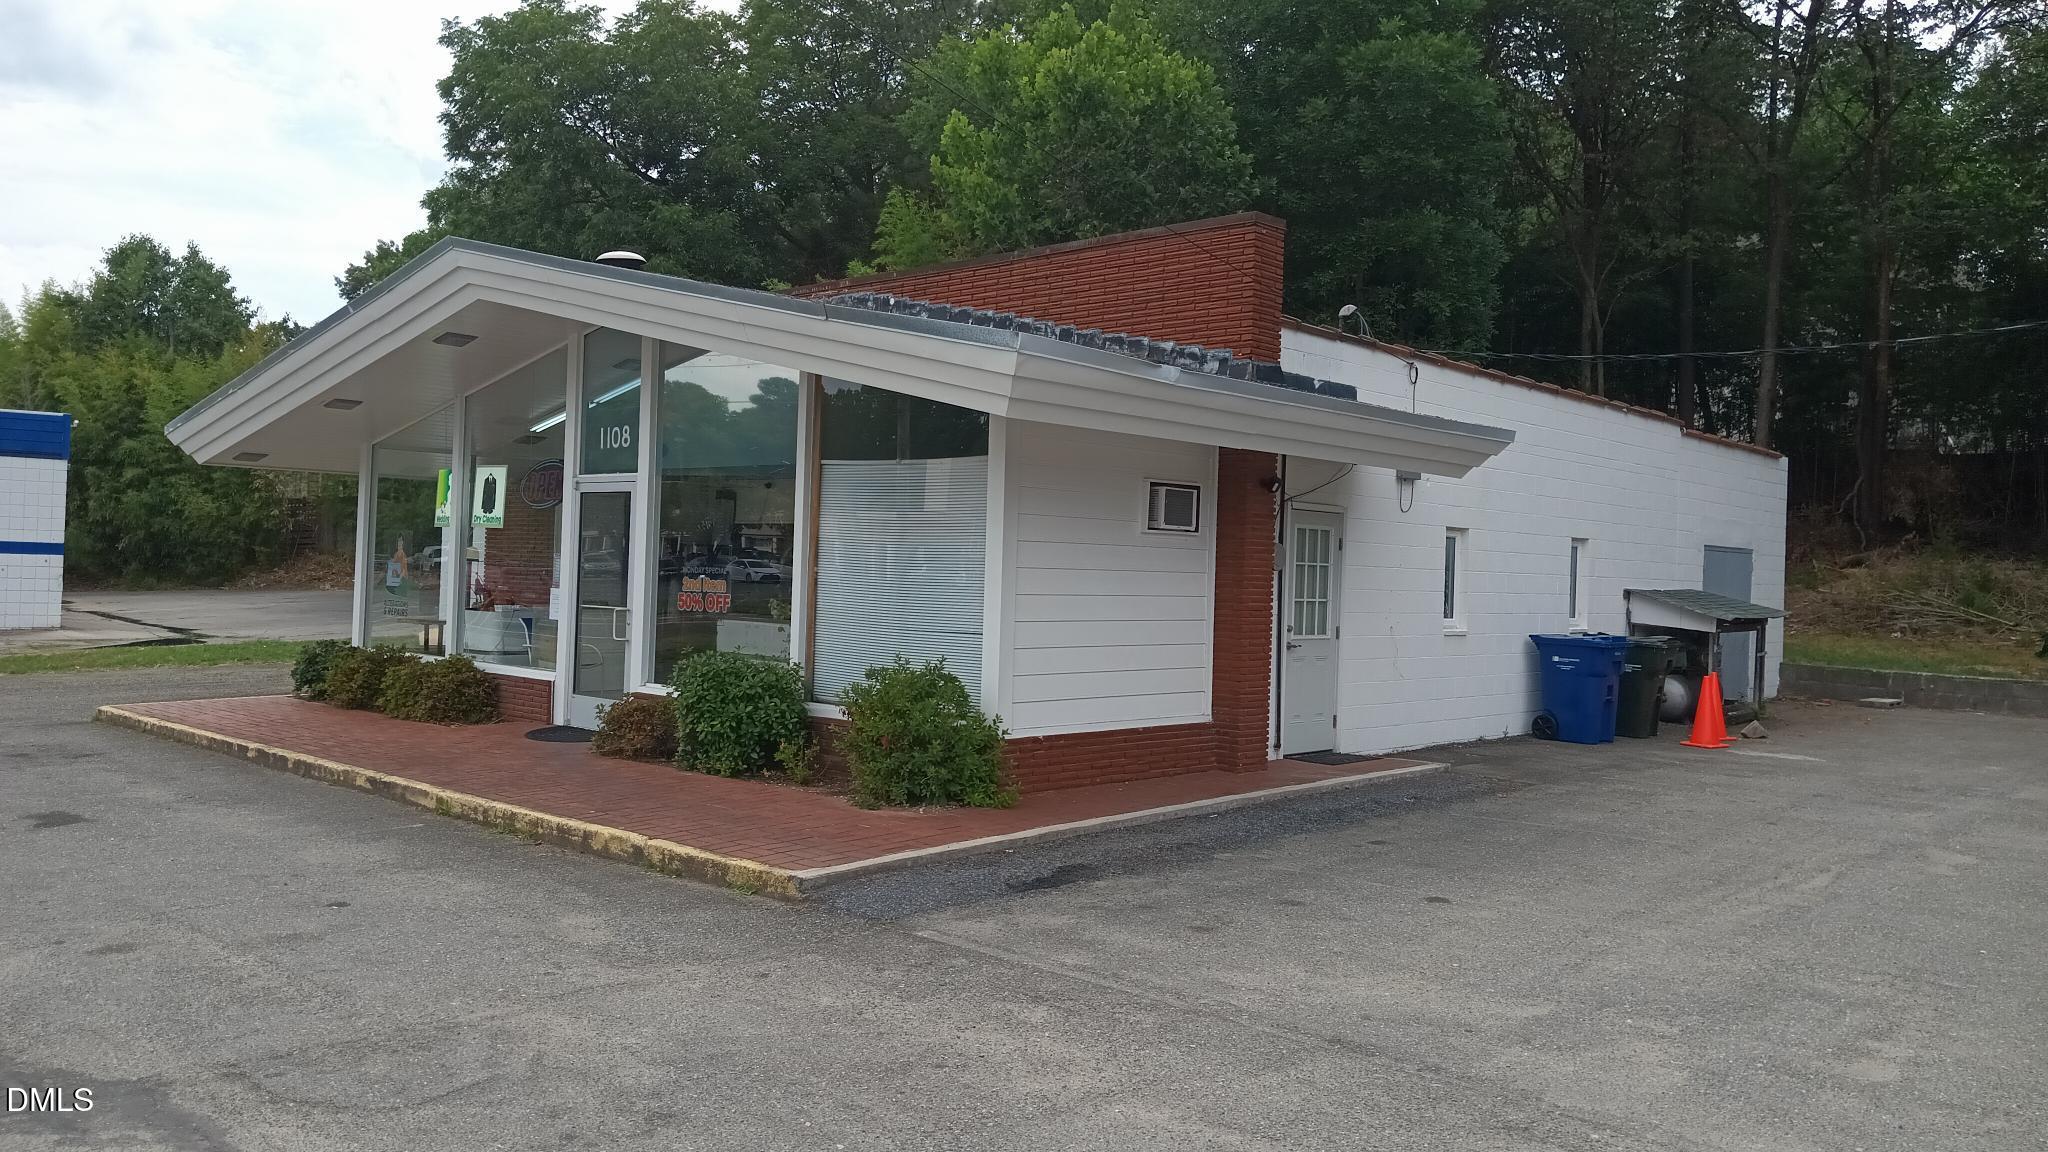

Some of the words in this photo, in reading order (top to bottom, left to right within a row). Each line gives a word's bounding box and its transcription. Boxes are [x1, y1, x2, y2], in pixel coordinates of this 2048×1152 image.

[600, 425, 630, 449] 1108
[473, 515, 481, 524] Dry
[482, 515, 502, 525] Cleaning
[682, 576, 702, 592] 2nd
[678, 592, 704, 612] 50%
[705, 592, 731, 613] OFF
